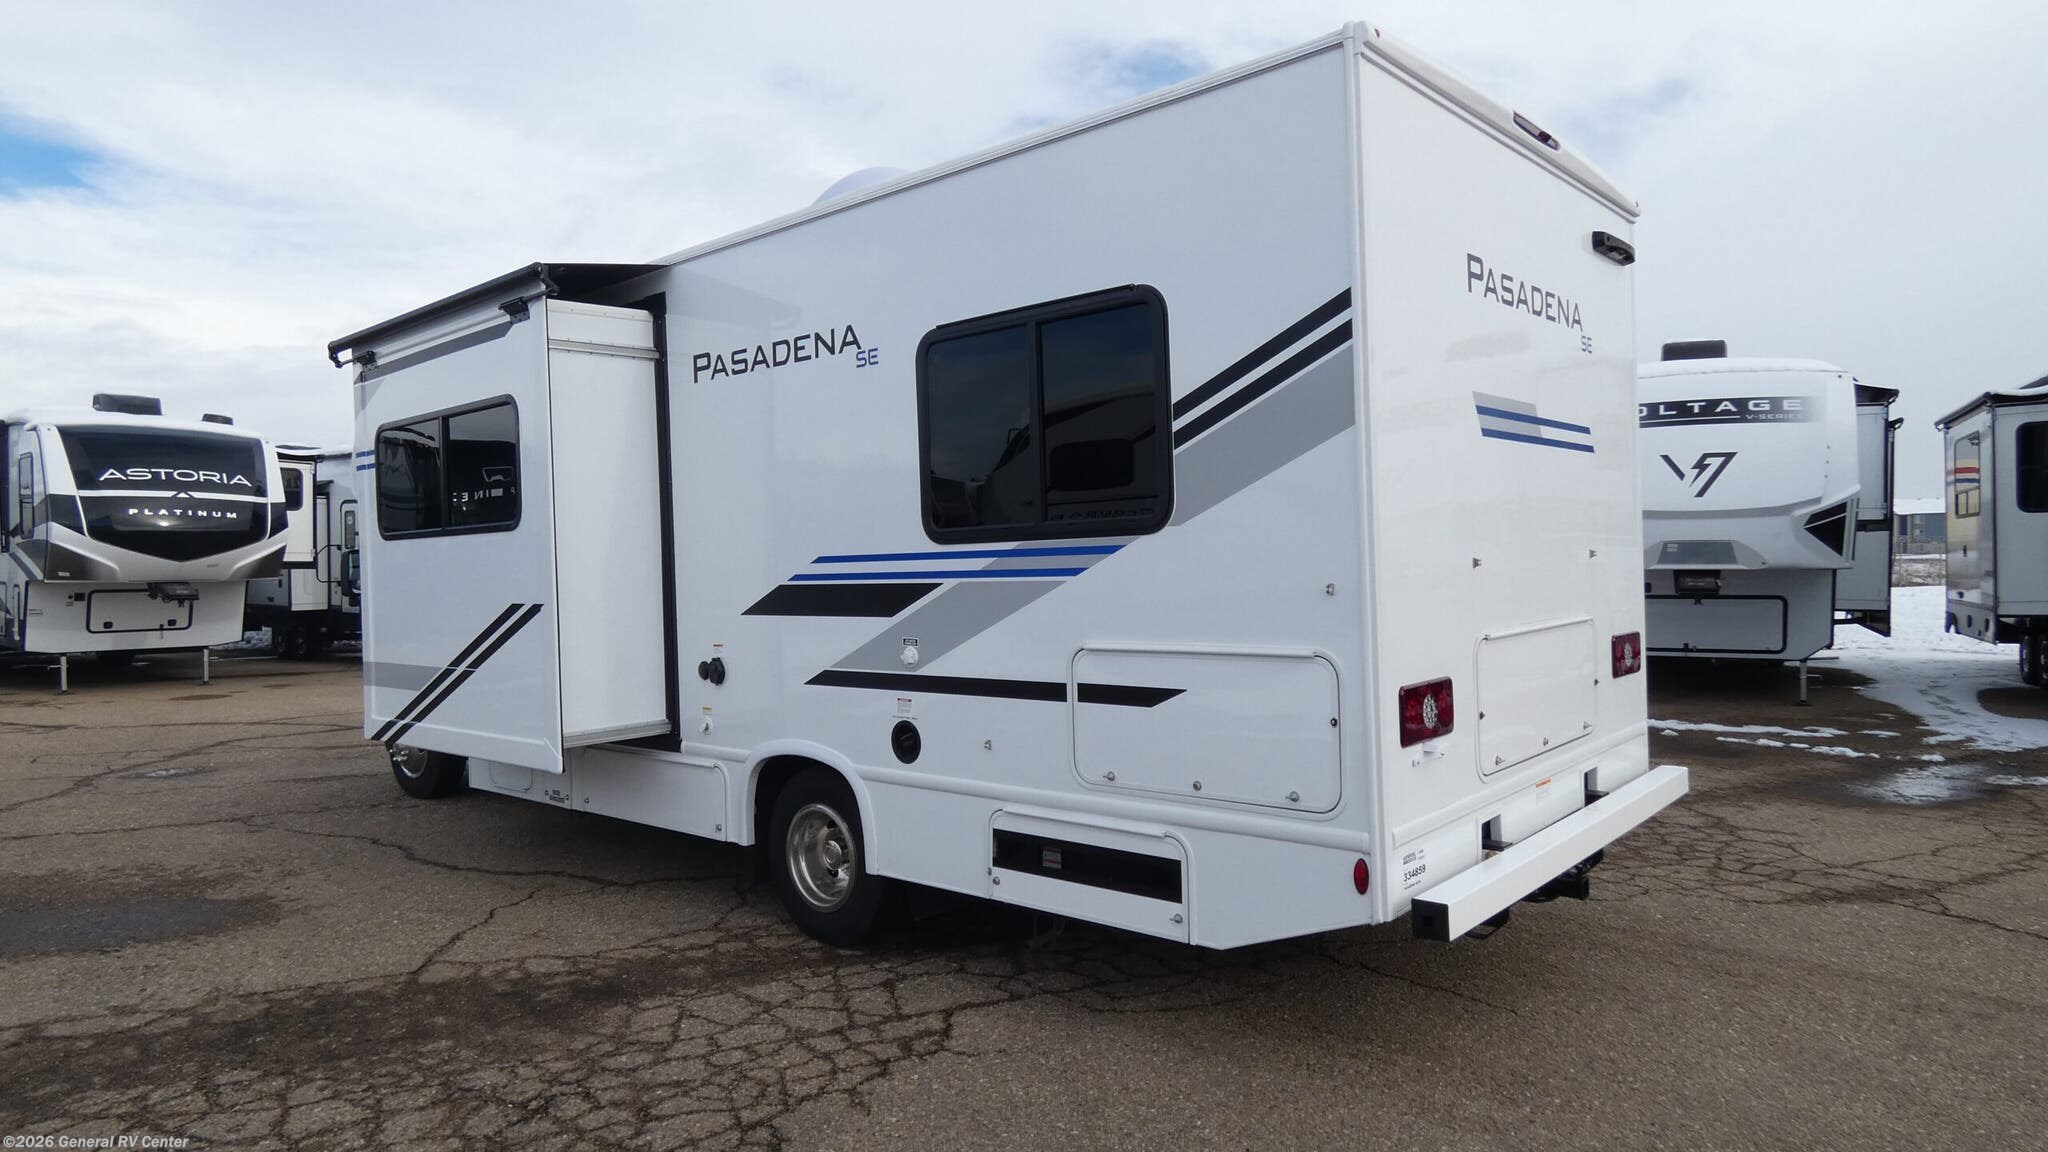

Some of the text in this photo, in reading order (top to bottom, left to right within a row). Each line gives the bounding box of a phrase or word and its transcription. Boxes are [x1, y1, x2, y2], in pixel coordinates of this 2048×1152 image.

[1466, 252, 1592, 354] PASADENA SE
[693, 324, 879, 384] PASADENA SE
[98, 468, 252, 487] ASTORIA
[128, 508, 237, 519] PLATINUM
[1403, 863, 1426, 882] 334859
